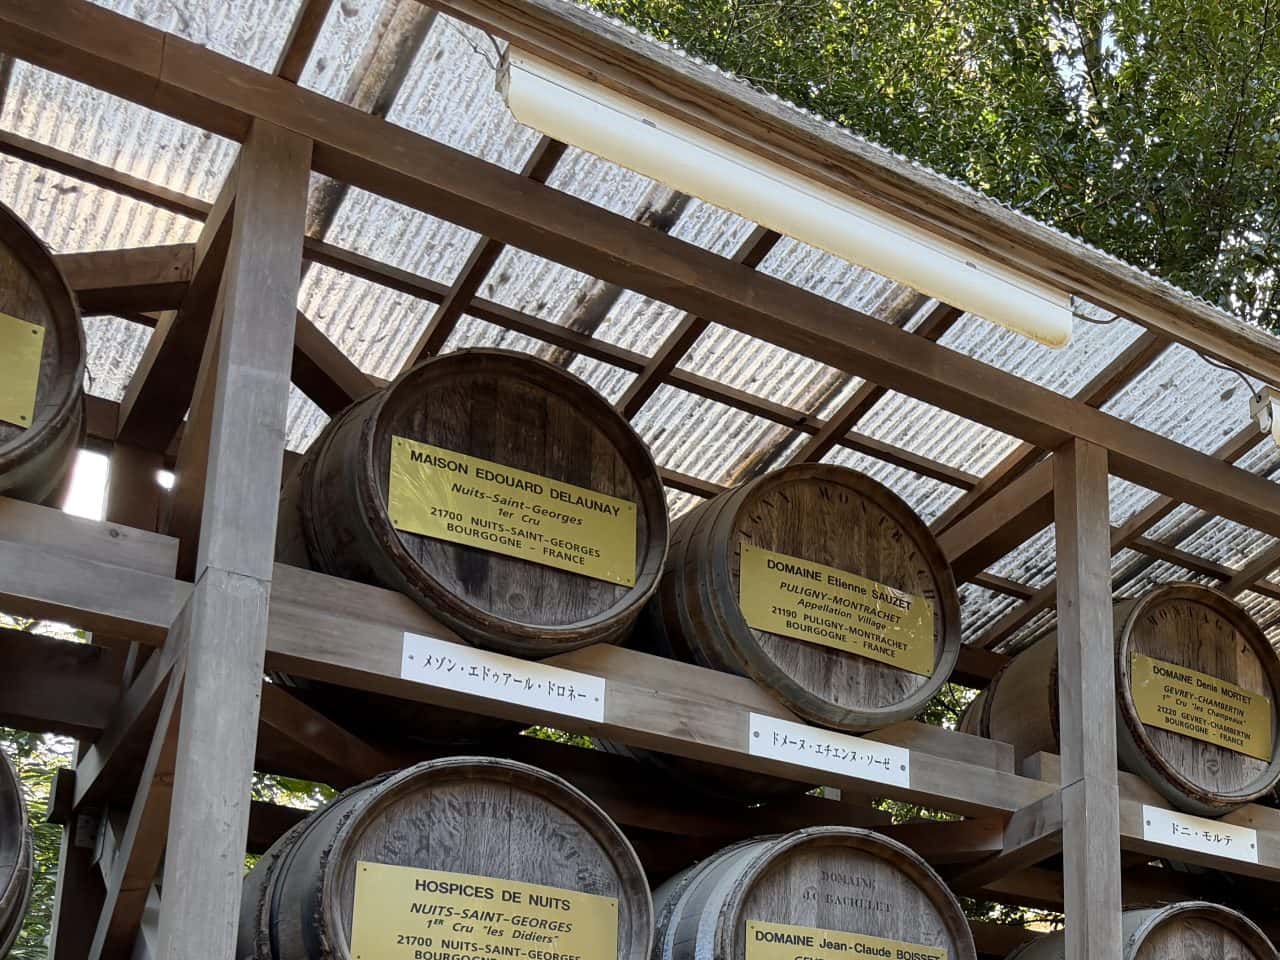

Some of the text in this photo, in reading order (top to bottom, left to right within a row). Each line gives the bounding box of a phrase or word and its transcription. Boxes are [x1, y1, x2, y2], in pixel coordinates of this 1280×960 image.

[410, 450, 621, 517] MAISON EDOUARD DELAUNAY
[451, 483, 584, 526] Nuits-Saint-Georges
[498, 508, 541, 526] 1er Cru
[430, 507, 601, 558] 21700 NUITS-SAINT-GEORGES
[446, 523, 586, 566] BOURGOGNE FRANCE
[767, 559, 912, 611] DOMAINE Etienne SAUZET
[780, 582, 902, 625] PULIGNY-MONTRACHET
[797, 598, 887, 631] Appellation Village
[771, 606, 908, 651] 21190 PULIGNY-MONTRACHET
[786, 620, 897, 658] BOURGOGNE FRANCE
[1152, 665, 1252, 705] DOMAINE Denis MORTET
[1163, 685, 1245, 717] GEVREY-CHAMBERTIN
[1175, 698, 1188, 708] Cru
[1156, 704, 1252, 741] 21220 GEVREY-CHAMBERTIN
[1164, 716, 1245, 747] BOURGOGNE FRANCE
[415, 879, 571, 911] HOSPICES DE NUITS
[410, 903, 573, 933] NUITS-SAINT-GEORGES
[452, 922, 474, 934] Cru
[511, 929, 559, 944] Didiers"
[396, 935, 433, 947] 21700
[755, 930, 814, 947] DOMAINE
[819, 938, 892, 958] Jean-Claude
